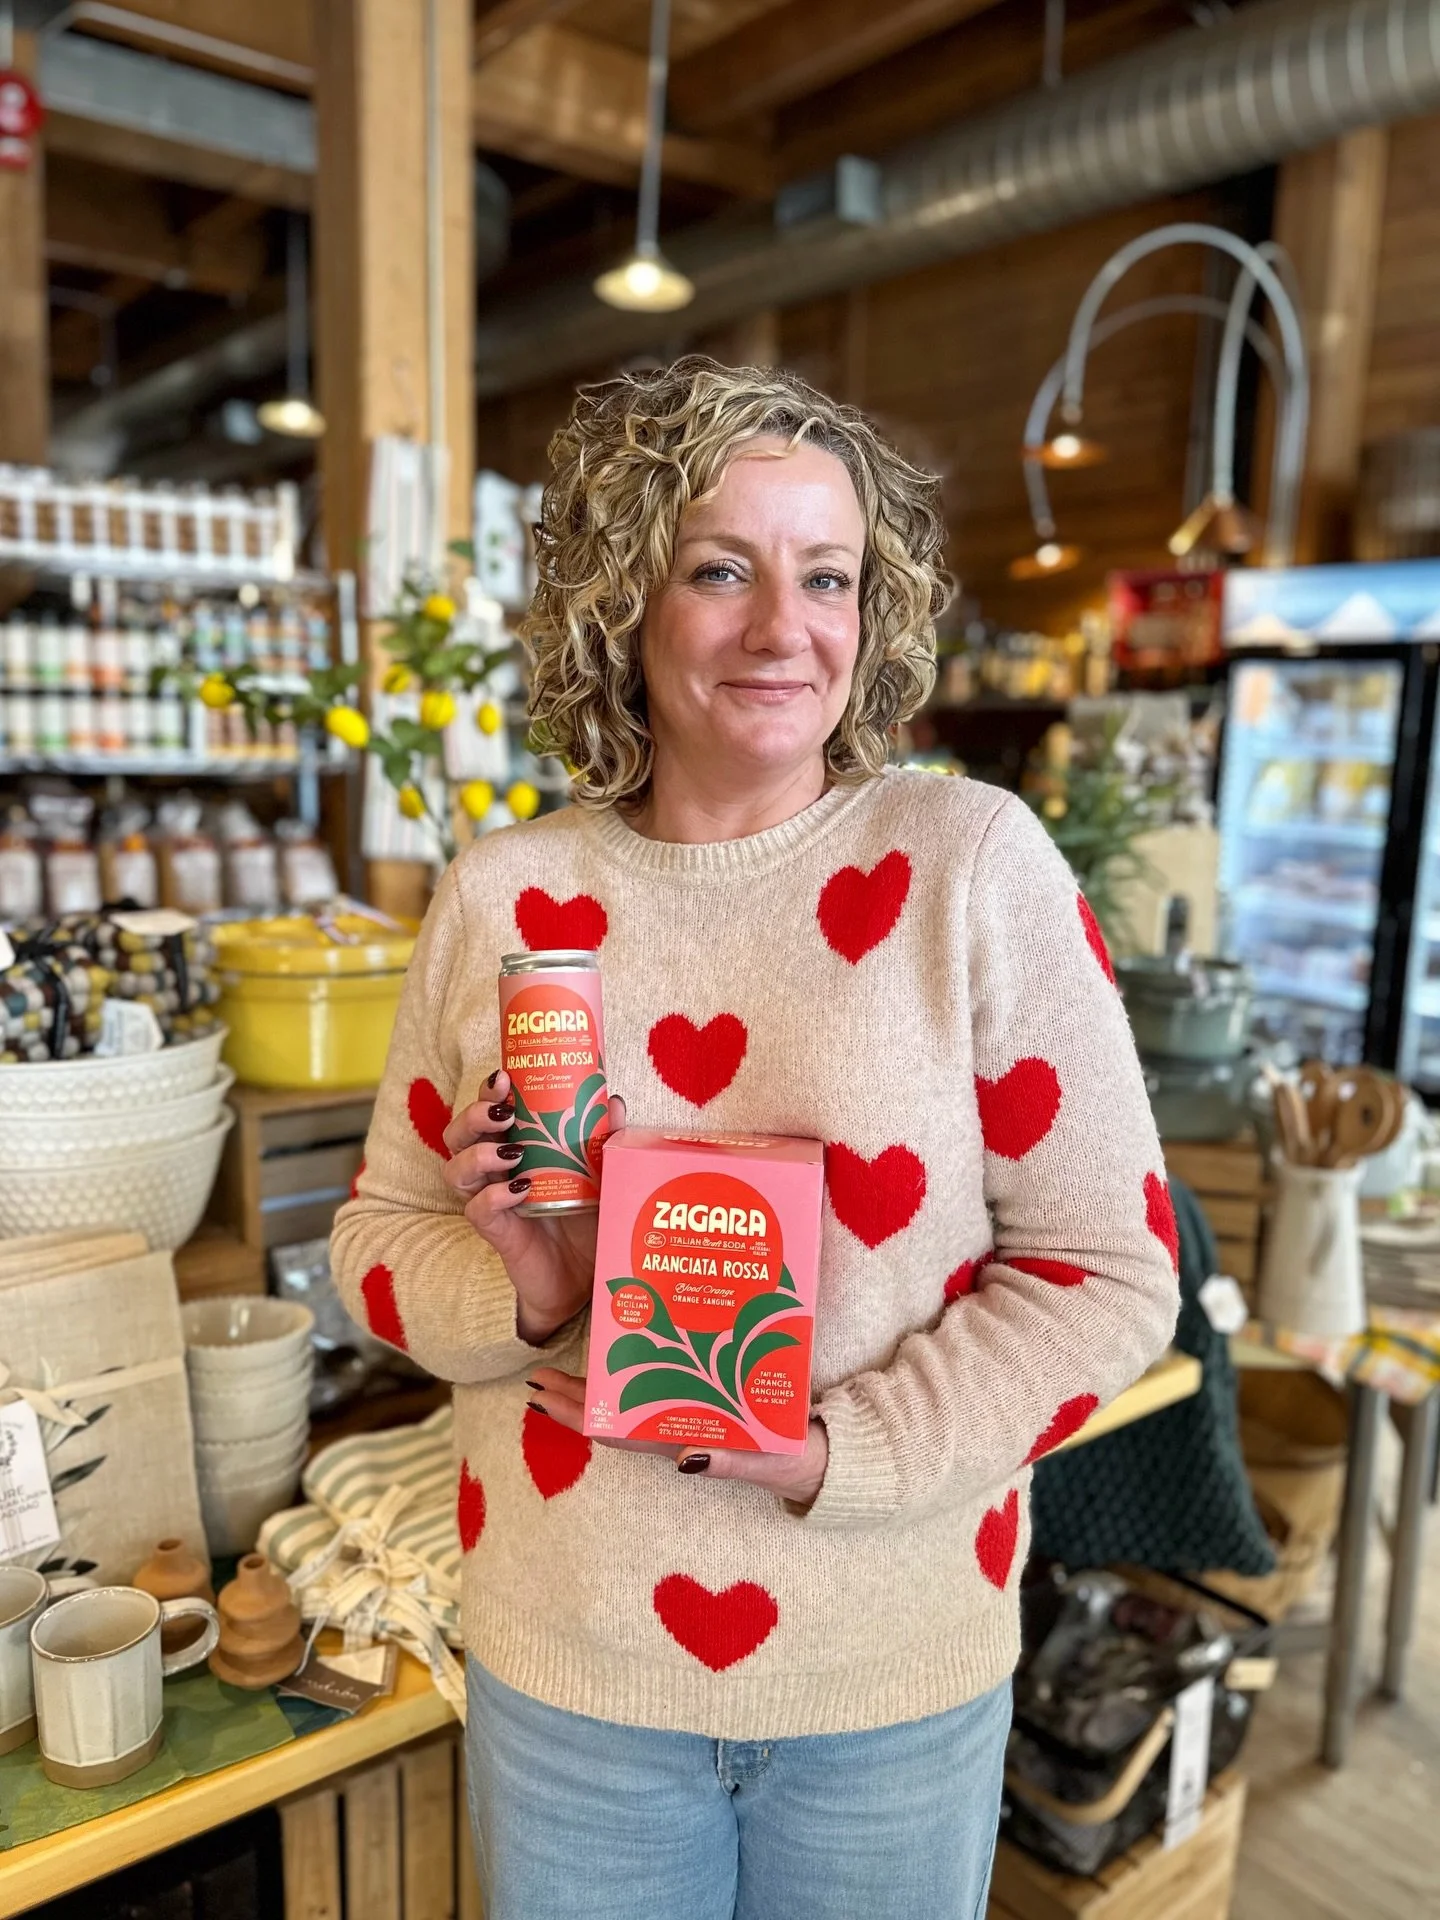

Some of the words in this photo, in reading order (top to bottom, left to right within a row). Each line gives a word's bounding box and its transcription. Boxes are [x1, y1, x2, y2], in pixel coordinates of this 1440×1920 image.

[508, 1009, 589, 1035] ZAGARA
[518, 1038, 541, 1046] ITALIAN
[506, 1053, 557, 1070] ARANCIATA
[561, 1051, 594, 1066] ROSSA
[652, 1201, 767, 1237] ZAGARA
[670, 1236, 701, 1246] ITALIAN
[722, 1240, 746, 1249] SODA
[642, 1253, 718, 1276] ARANCIATA
[723, 1260, 769, 1281] ROSSA
[675, 1282, 704, 1293] Blood
[703, 1284, 735, 1297] Orange
[616, 1300, 649, 1310] SICILIAN
[672, 1295, 699, 1304] ORANGE
[703, 1297, 736, 1307] SANGUINE
[753, 1377, 792, 1388] ORANGES
[750, 1387, 795, 1397] SANGUINES
[702, 1418, 720, 1427] JUICE
